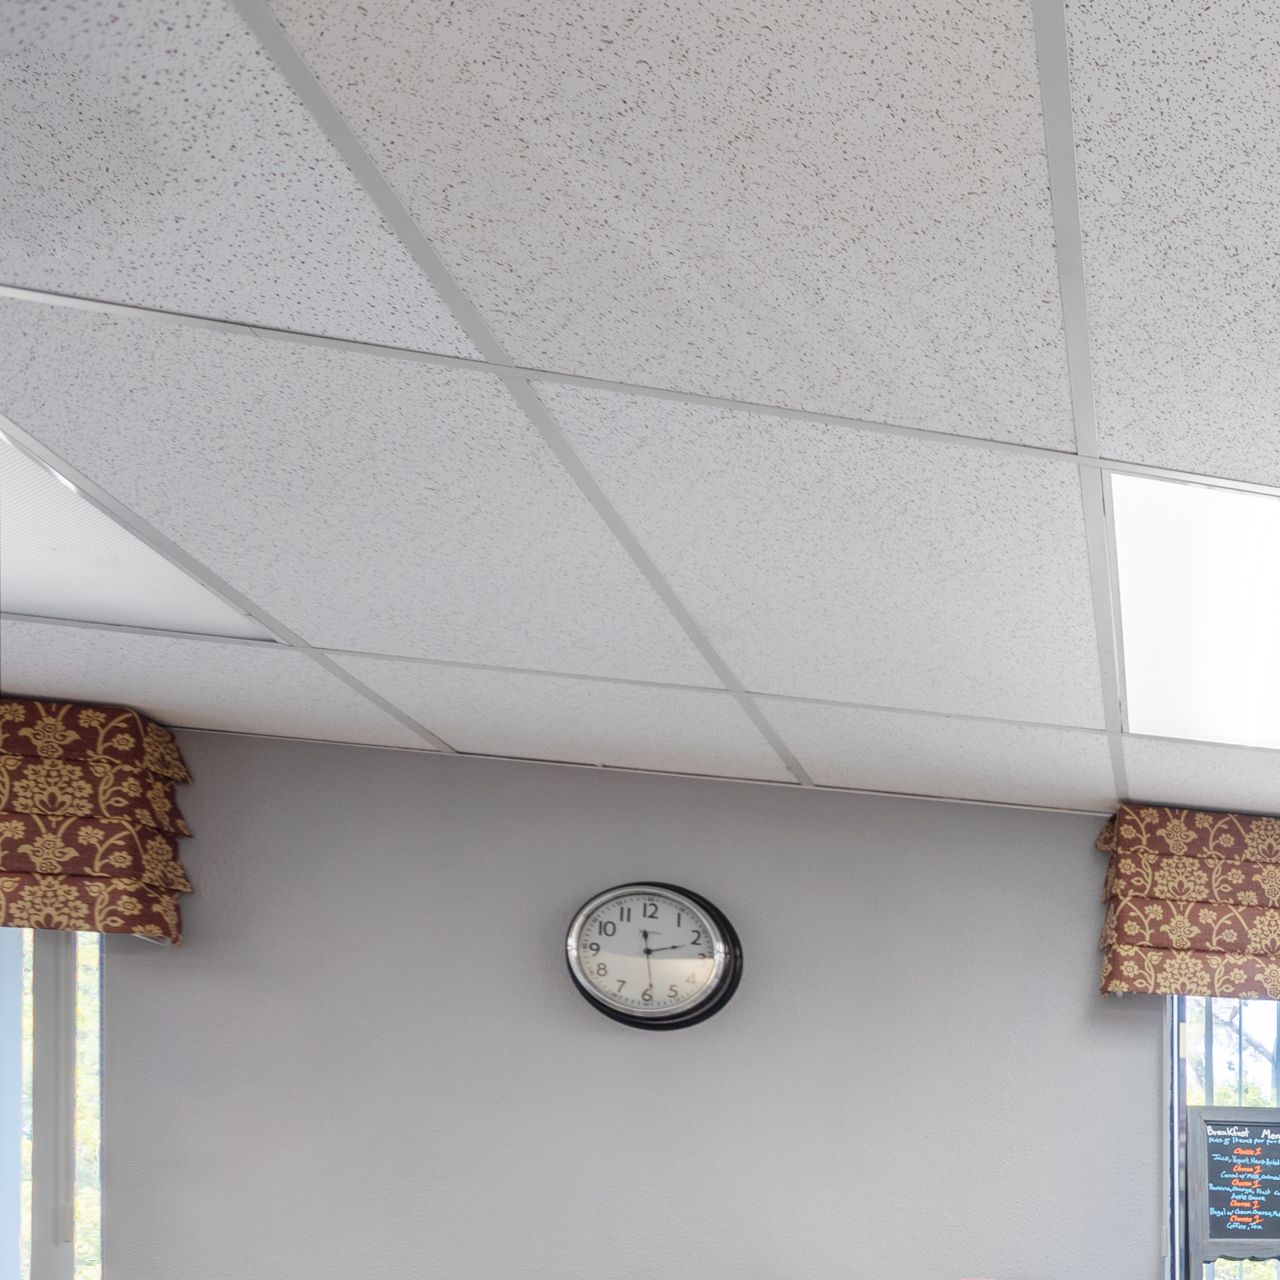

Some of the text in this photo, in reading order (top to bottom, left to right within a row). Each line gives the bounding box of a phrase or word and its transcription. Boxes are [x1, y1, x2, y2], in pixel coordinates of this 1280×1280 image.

[620, 906, 631, 922] 11
[643, 902, 659, 919] 12
[598, 920, 616, 936] 10
[676, 913, 681, 928] 1
[690, 930, 701, 945] 2
[589, 942, 600, 957] 9
[596, 962, 608, 976] 8
[616, 980, 626, 992] 7
[668, 984, 678, 998] 5
[641, 988, 653, 1002] 6
[1206, 1125, 1250, 1137] Breakfast
